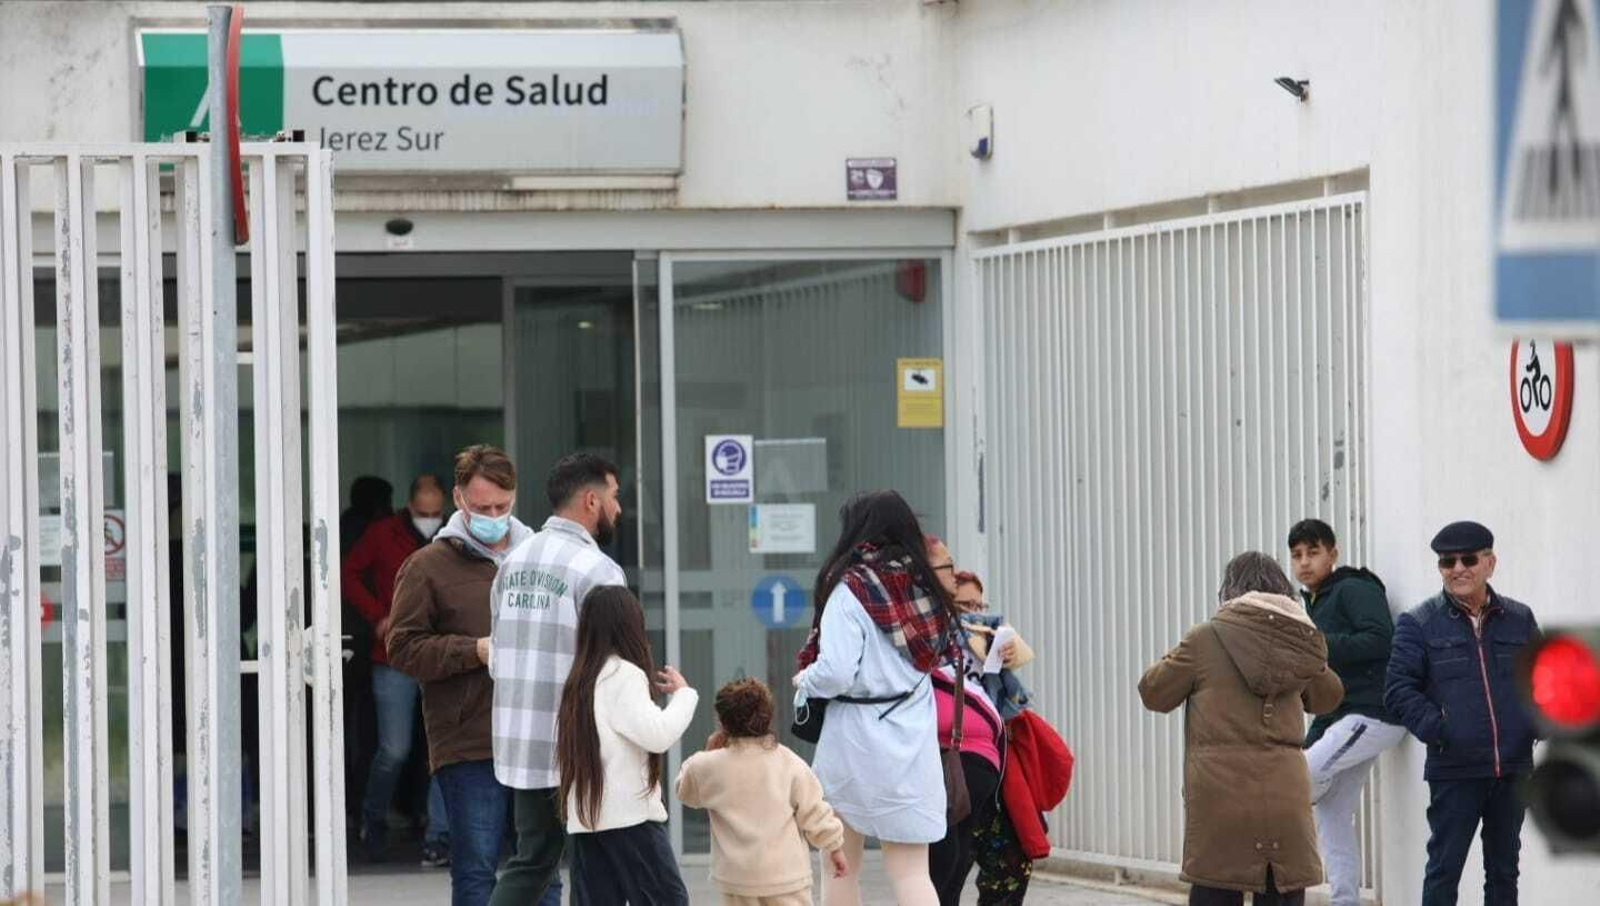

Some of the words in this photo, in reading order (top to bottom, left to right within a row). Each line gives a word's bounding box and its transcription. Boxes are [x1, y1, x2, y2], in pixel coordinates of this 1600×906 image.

[312, 75, 438, 106] Centro
[449, 73, 493, 106] de
[505, 73, 609, 106] Salud
[318, 127, 388, 151] Jerez
[397, 126, 445, 151] Sur
